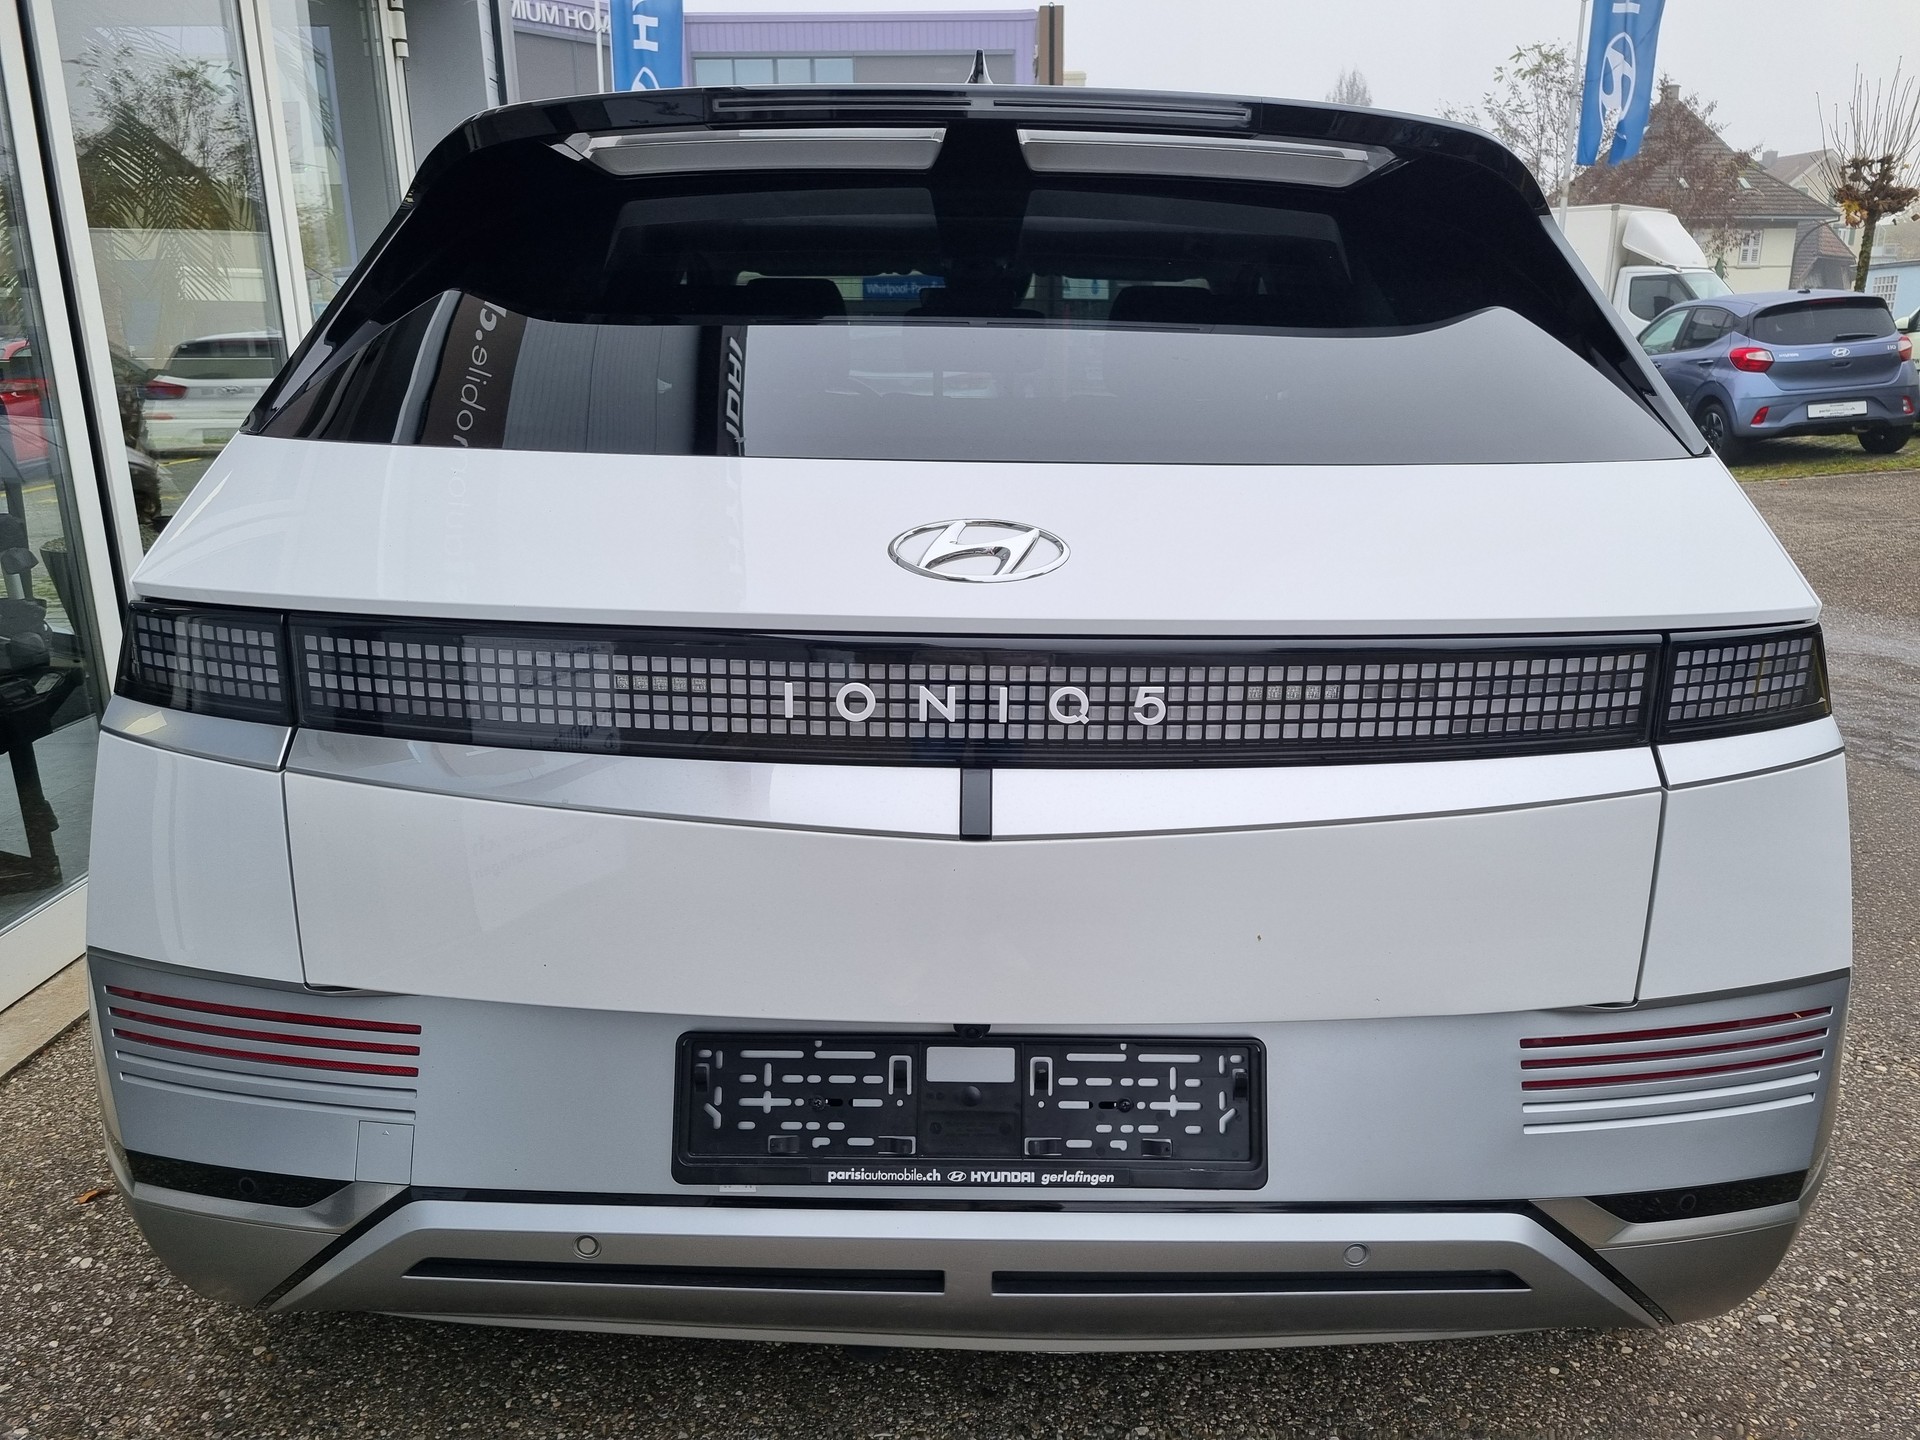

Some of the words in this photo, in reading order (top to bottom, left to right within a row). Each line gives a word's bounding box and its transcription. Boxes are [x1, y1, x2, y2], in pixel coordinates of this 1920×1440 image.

[784, 682, 1090, 724] IONIQ
[1133, 686, 1166, 725] 5
[827, 1167, 941, 1183] parisiautomobile.ch
[970, 1171, 1035, 1183] HYUNDAI
[1041, 1170, 1115, 1185] gerlafingen
